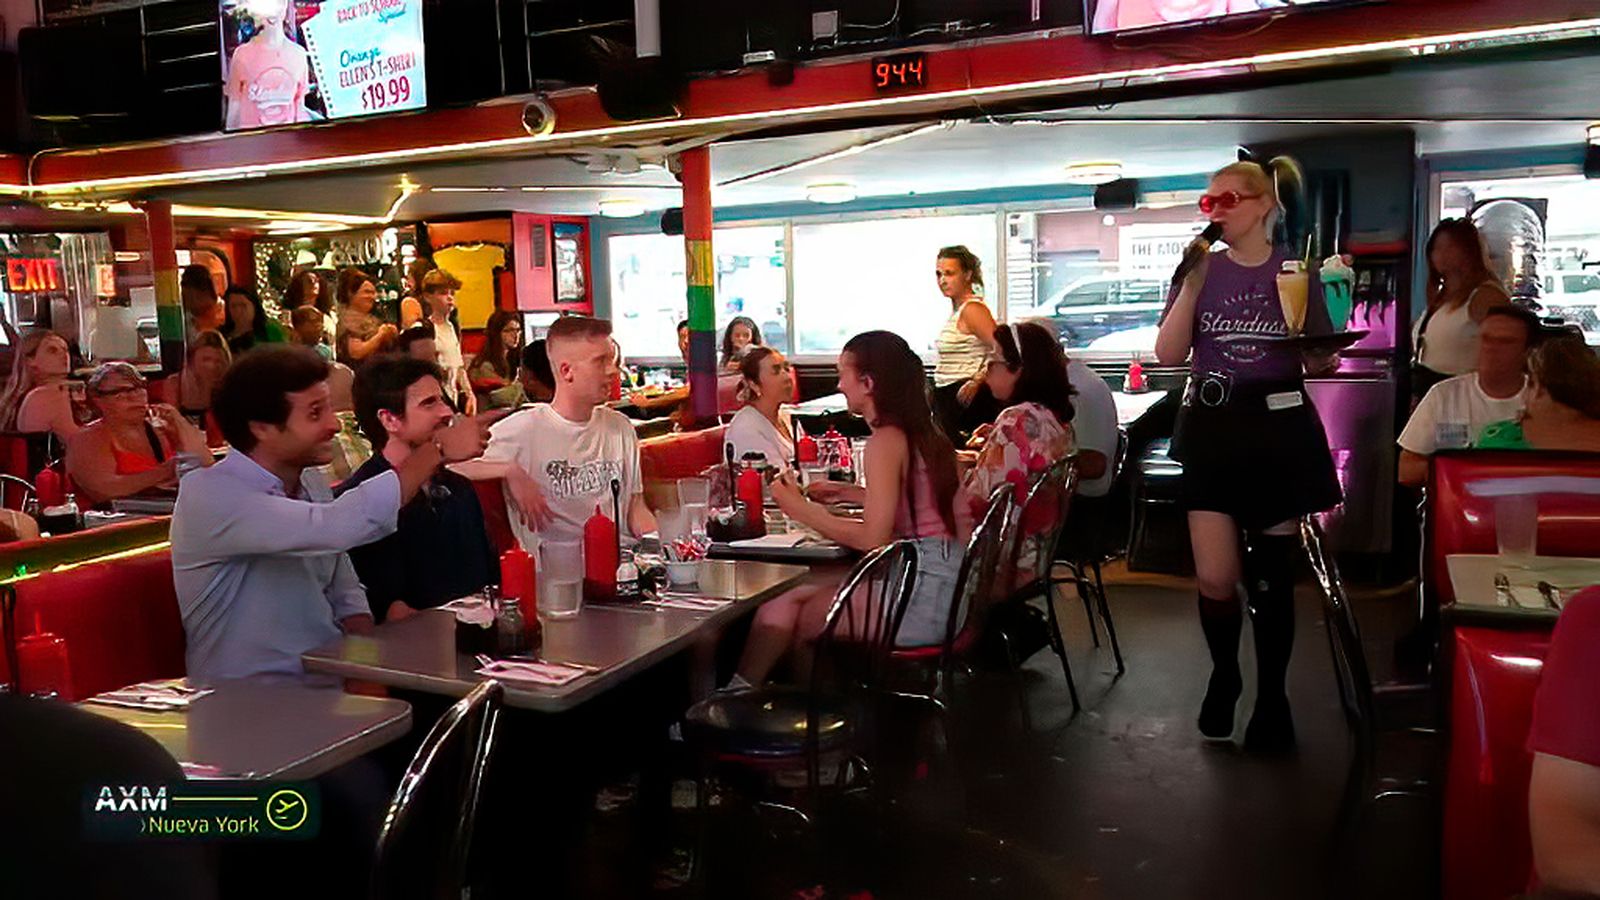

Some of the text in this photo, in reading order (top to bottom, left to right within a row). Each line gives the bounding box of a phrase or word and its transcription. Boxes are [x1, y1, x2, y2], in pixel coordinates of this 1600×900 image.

[340, 47, 381, 68] Orange
[362, 75, 410, 110] $19.99
[7, 258, 57, 291] EXIT
